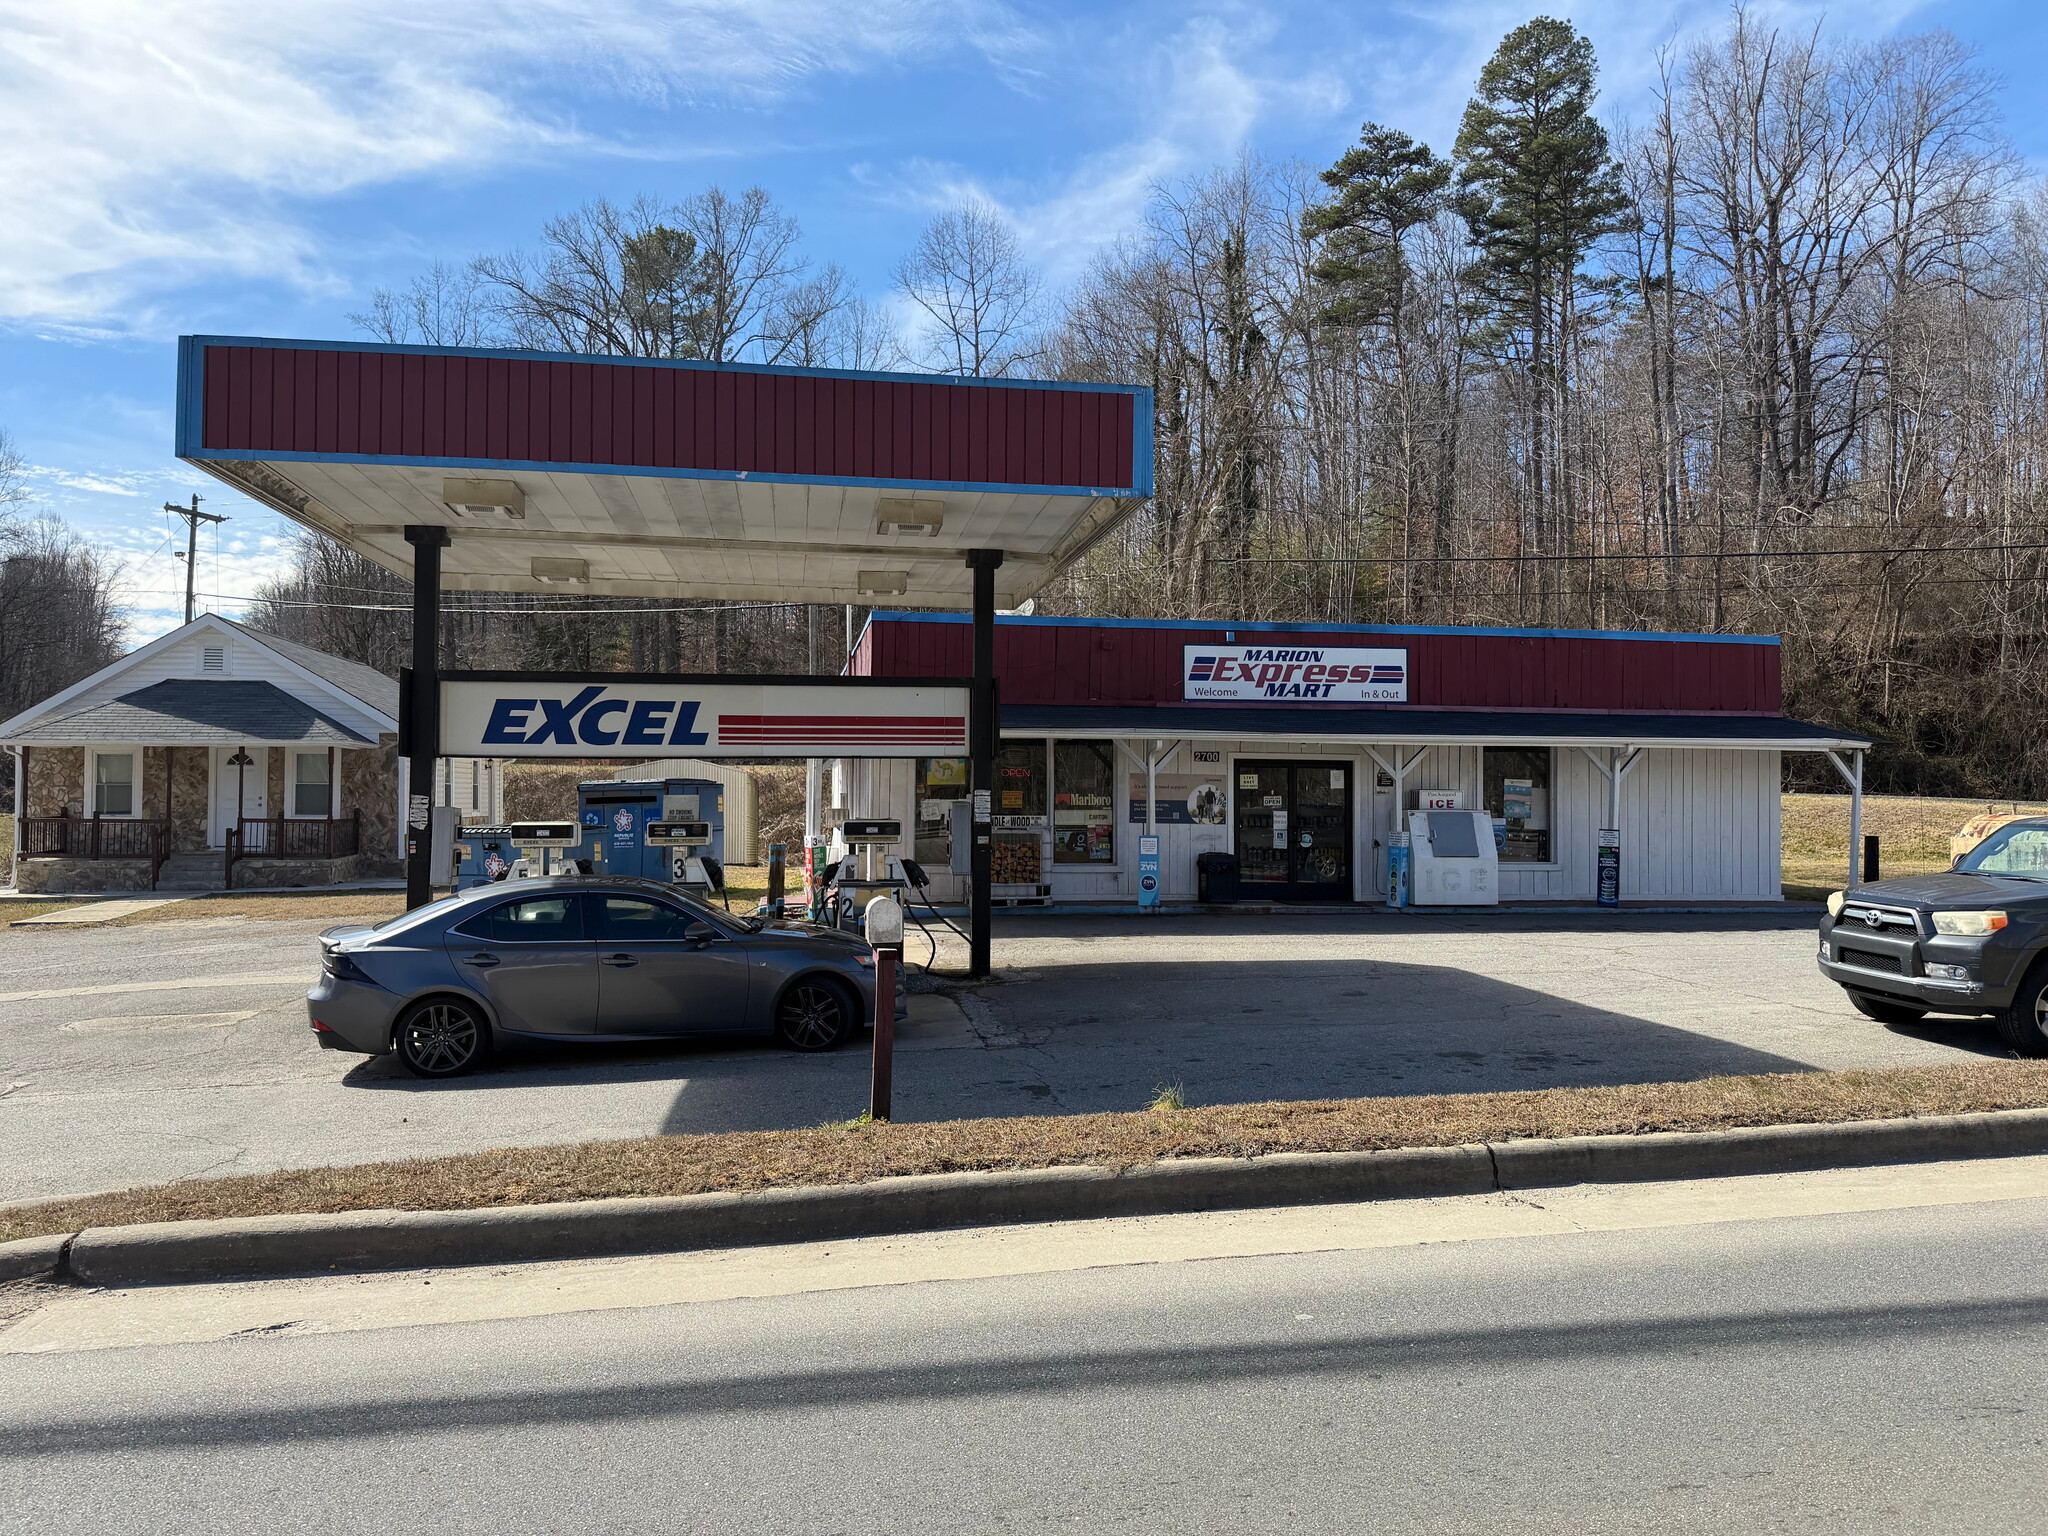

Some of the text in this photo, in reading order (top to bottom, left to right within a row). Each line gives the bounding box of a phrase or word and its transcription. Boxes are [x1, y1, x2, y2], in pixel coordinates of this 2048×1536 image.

[1243, 649, 1325, 662] MARION
[1210, 657, 1373, 688] Express
[1194, 687, 1239, 698] Welcome
[1263, 683, 1336, 698] MART
[1361, 689, 1400, 700] In & Out
[481, 685, 709, 746] EXCEL
[1195, 753, 1219, 761] 2700
[1000, 768, 1031, 778] OPEN
[1070, 793, 1112, 806] Marlboro
[1429, 799, 1454, 809] ICE
[1010, 816, 1031, 827] WOOD
[673, 858, 684, 879] 3
[1426, 868, 1488, 892] ICE
[842, 898, 853, 919] 2
